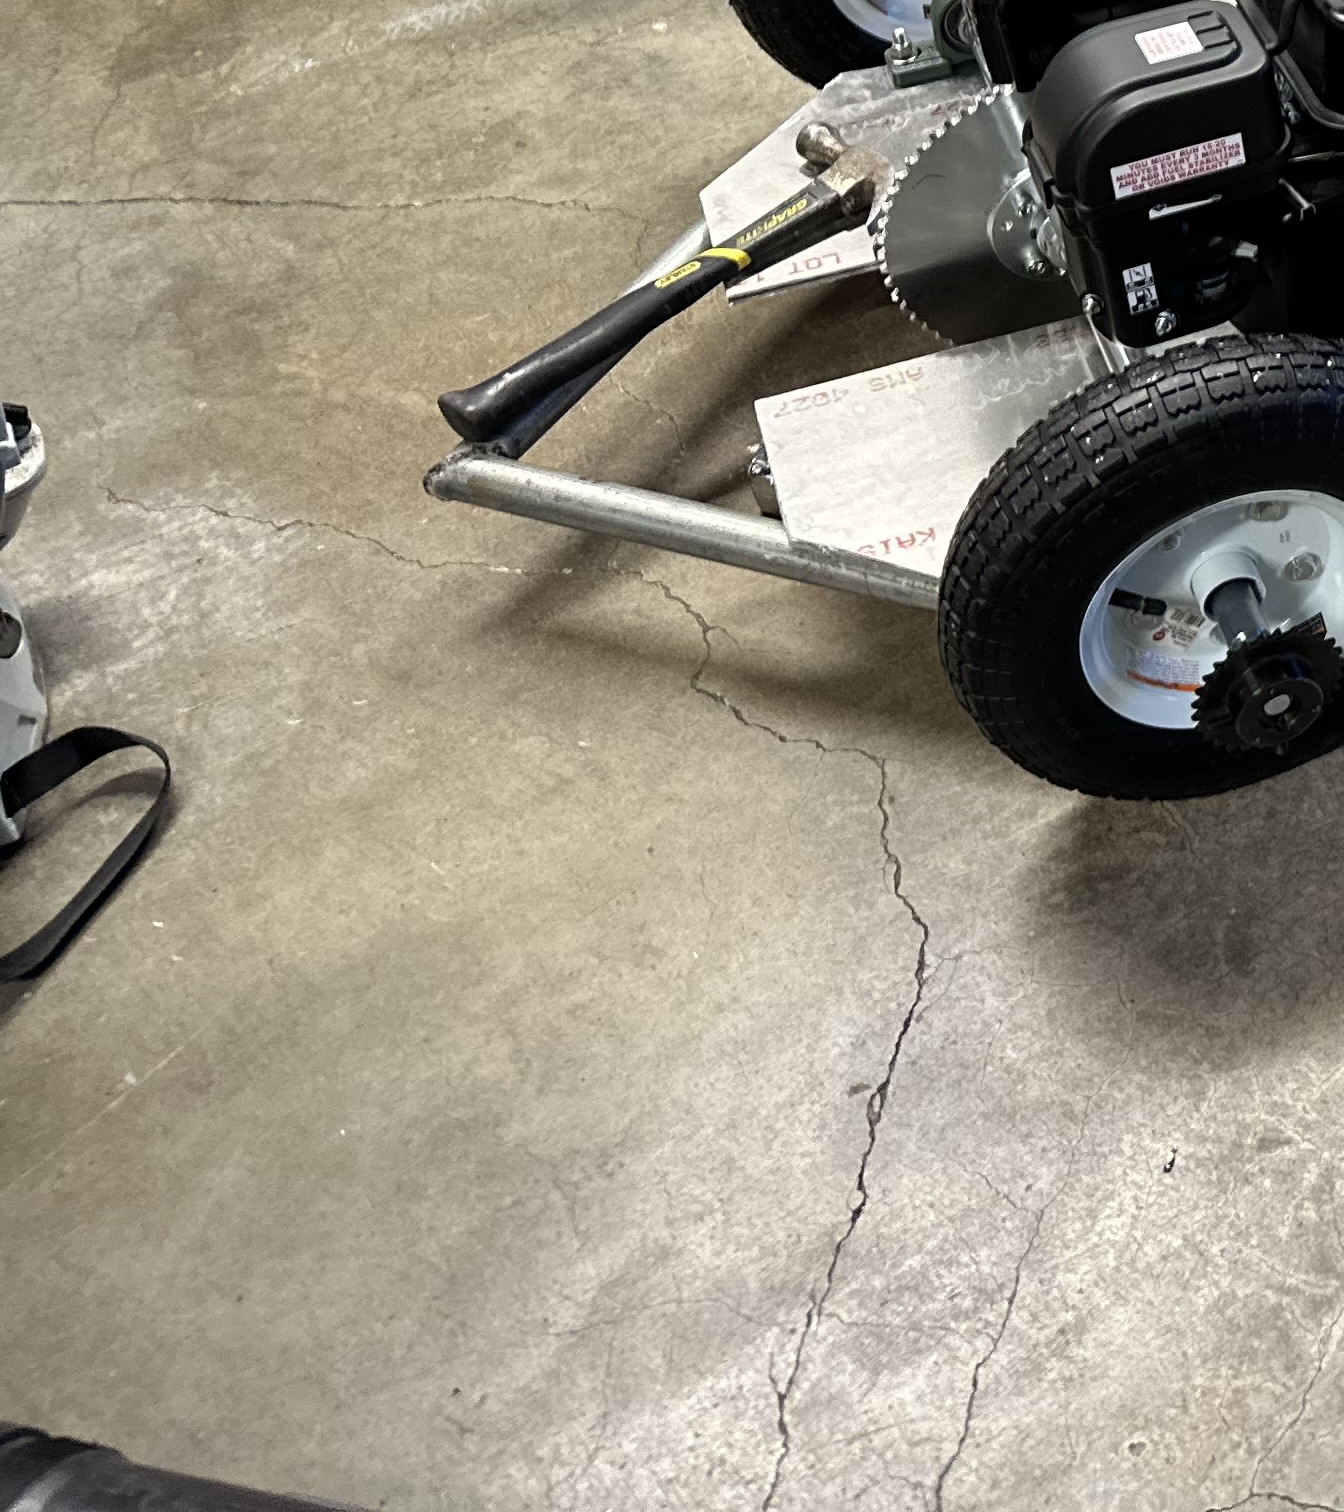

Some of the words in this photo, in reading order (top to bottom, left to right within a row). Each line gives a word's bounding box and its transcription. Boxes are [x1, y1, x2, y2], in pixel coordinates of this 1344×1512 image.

[1115, 165, 1159, 182] MINUTES
[1160, 155, 1191, 169] EVERY
[1201, 141, 1241, 158] MONTHS
[1118, 178, 1139, 189] AND
[1140, 172, 1161, 183] ADD
[1161, 166, 1185, 178] FUEL
[1187, 149, 1242, 171] STABILIZER
[1128, 161, 1149, 172] YOU
[1150, 152, 1178, 165] MUST
[1179, 146, 1200, 157] RUN
[1131, 183, 1146, 192] OR
[1178, 158, 1230, 179] WARRANTY
[735, 198, 808, 246] GRAPHITE
[790, 251, 842, 273] LOT
[865, 366, 923, 391] AMS
[773, 386, 850, 418] 4027
